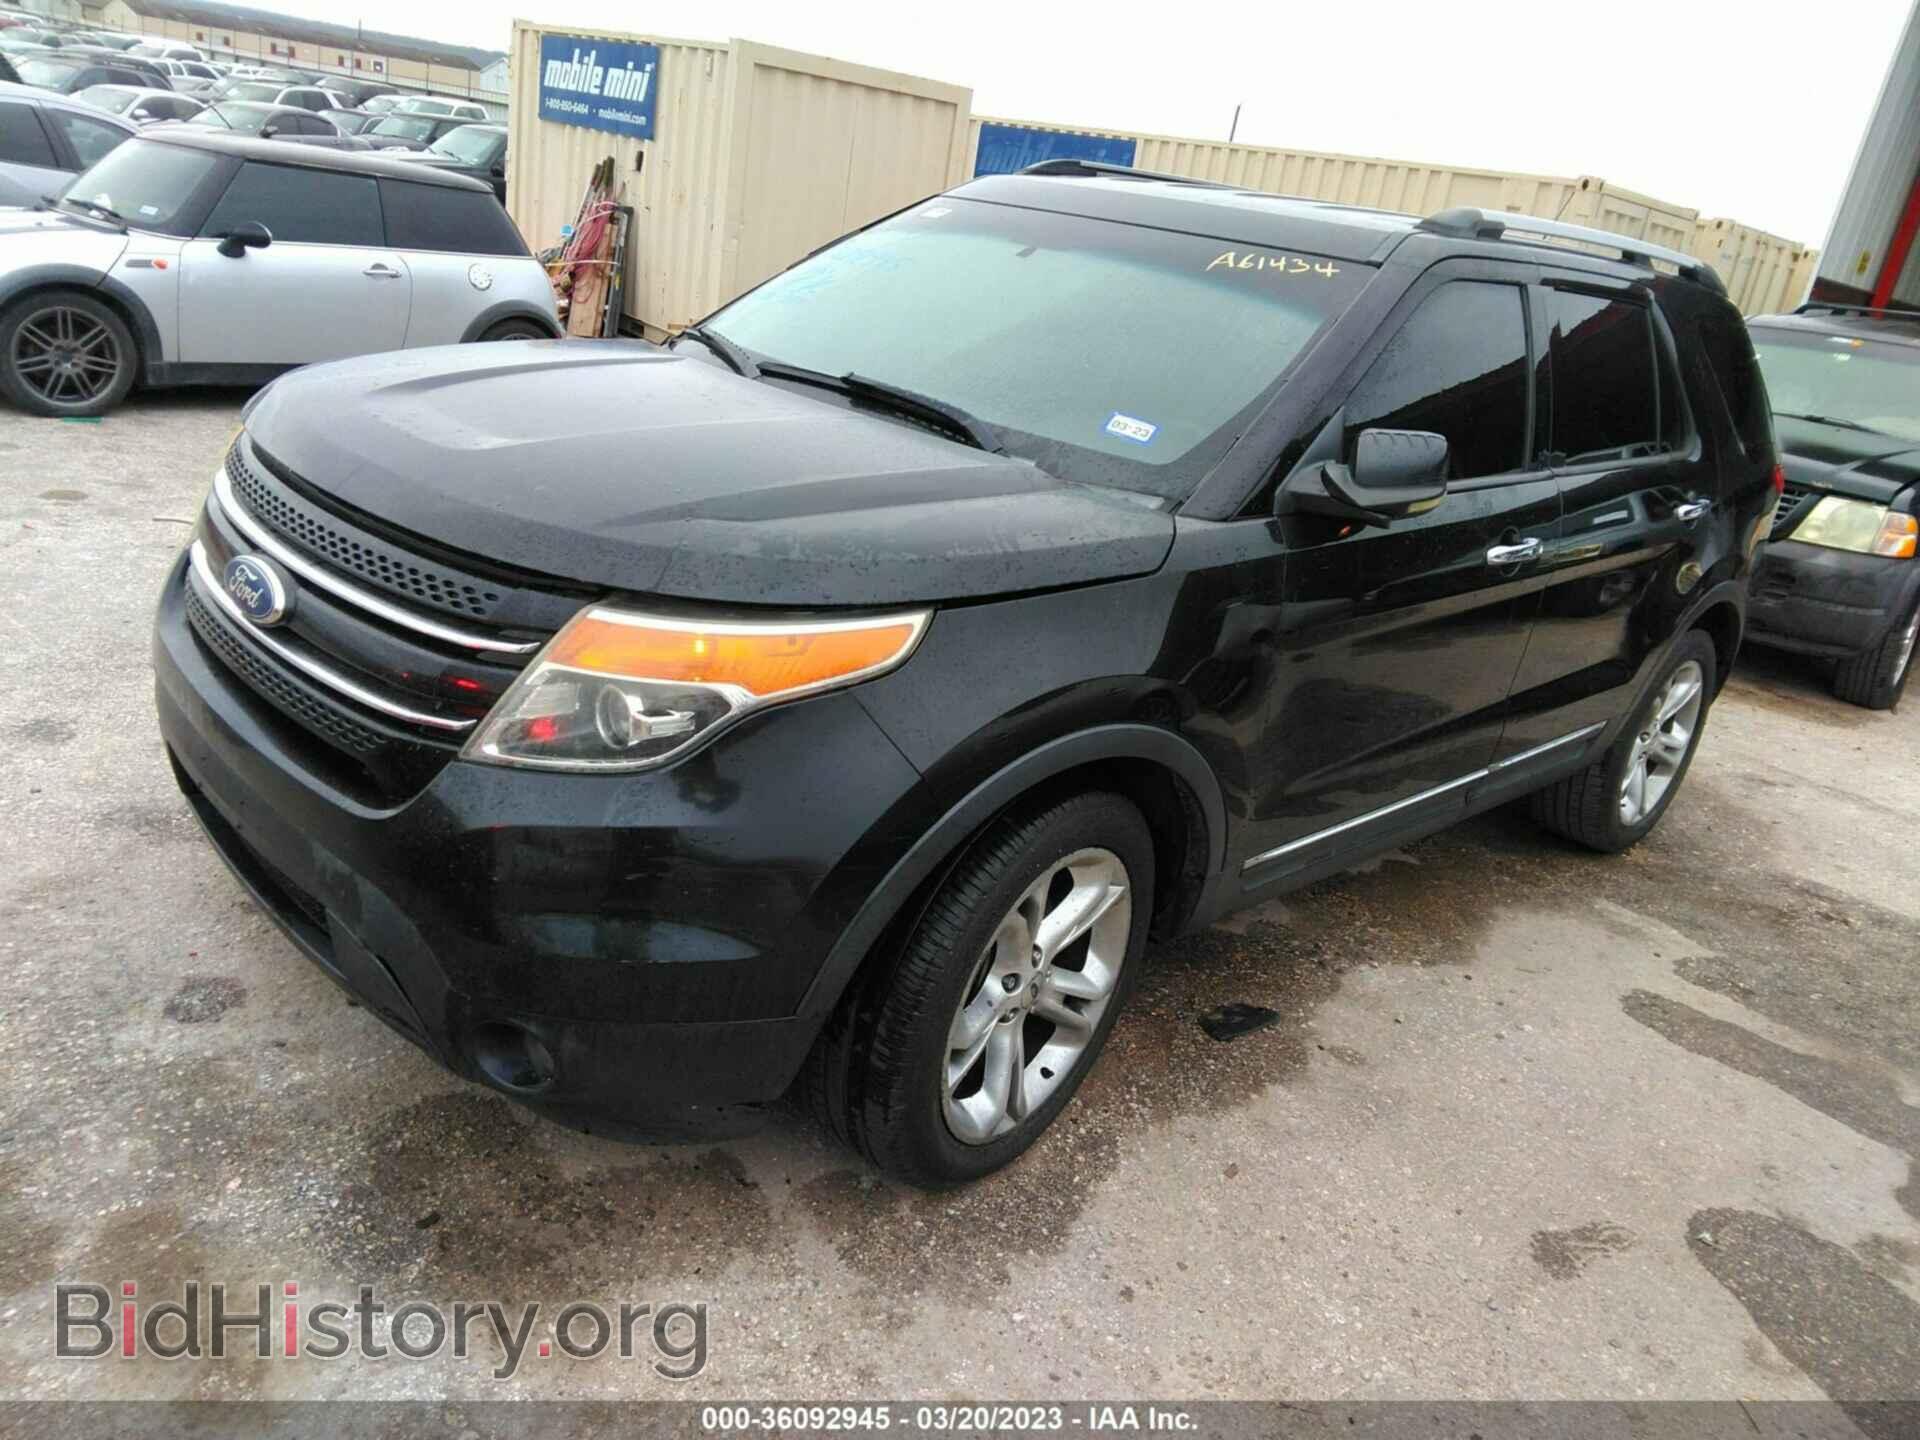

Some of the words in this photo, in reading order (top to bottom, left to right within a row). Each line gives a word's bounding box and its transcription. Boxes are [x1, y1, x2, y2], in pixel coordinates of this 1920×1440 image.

[543, 47, 604, 95] mobile
[603, 61, 651, 102] mini
[1205, 251, 1340, 278] A61434
[229, 564, 264, 609] Ford
